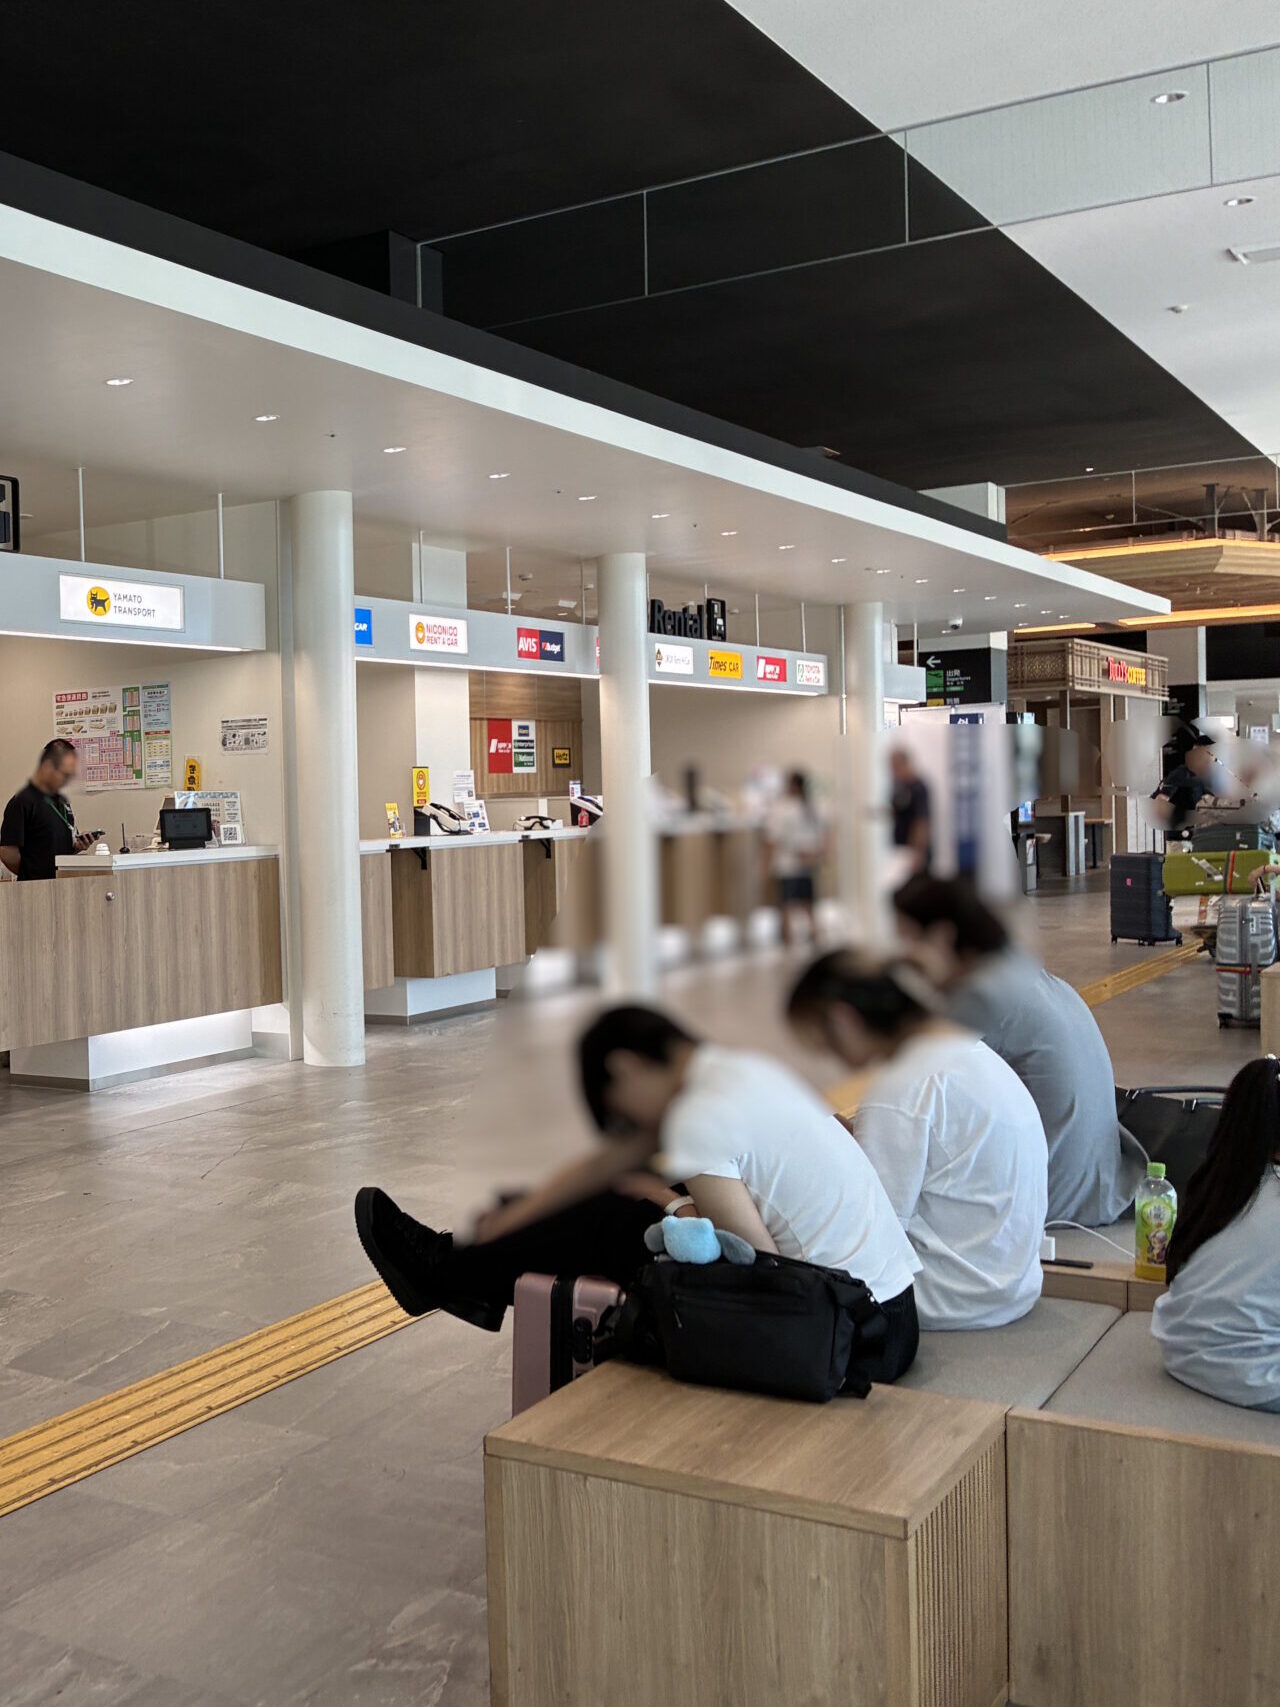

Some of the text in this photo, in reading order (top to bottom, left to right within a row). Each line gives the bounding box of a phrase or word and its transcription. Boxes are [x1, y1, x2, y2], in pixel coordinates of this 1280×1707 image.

[113, 592, 143, 604] YAMATO
[113, 605, 156, 619] TRANSPORT
[649, 599, 705, 640] Rental
[426, 623, 458, 637] NICONICO
[518, 636, 537, 653] AVIS
[709, 656, 739, 672] Times CAR
